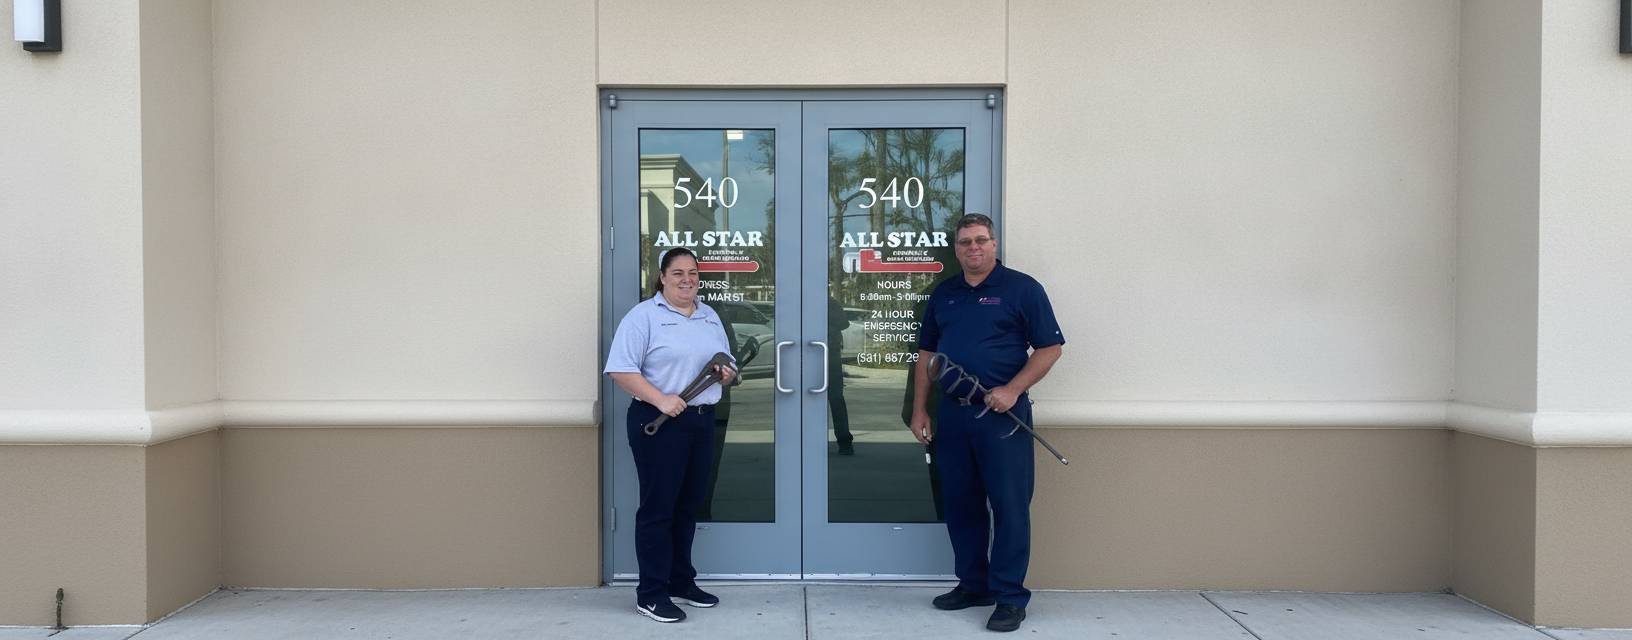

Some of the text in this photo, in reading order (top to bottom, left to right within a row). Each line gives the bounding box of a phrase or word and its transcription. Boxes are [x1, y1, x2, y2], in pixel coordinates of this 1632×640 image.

[674, 176, 738, 208] 540
[858, 176, 924, 208] 540
[654, 231, 763, 247] ALL STAR
[840, 231, 949, 248] ALL STAR
